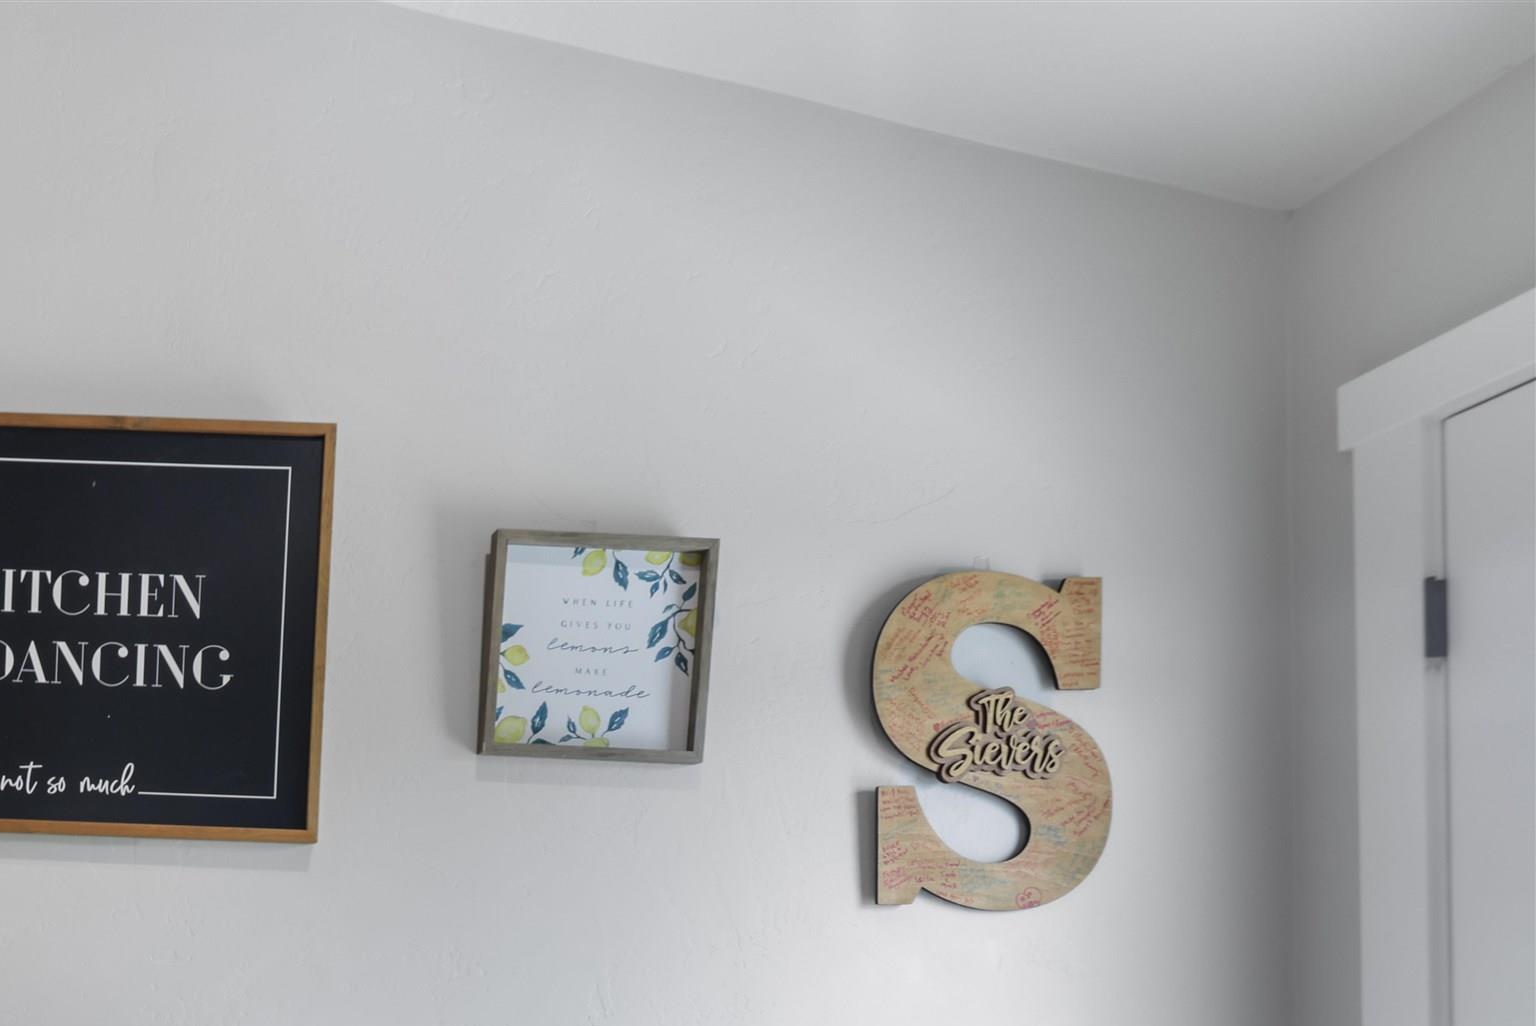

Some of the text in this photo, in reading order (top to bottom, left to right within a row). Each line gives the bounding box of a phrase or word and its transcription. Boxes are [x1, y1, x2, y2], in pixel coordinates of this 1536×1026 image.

[562, 597, 633, 609] WHEN LIFE
[560, 620, 632, 631] GIVES YOU
[546, 637, 639, 654] lemons
[575, 667, 608, 676] MAKE
[531, 680, 651, 699] lemonade
[976, 690, 1030, 735] The
[937, 725, 1065, 778] Sievers
[46, 775, 68, 796] so
[78, 763, 136, 798] much
